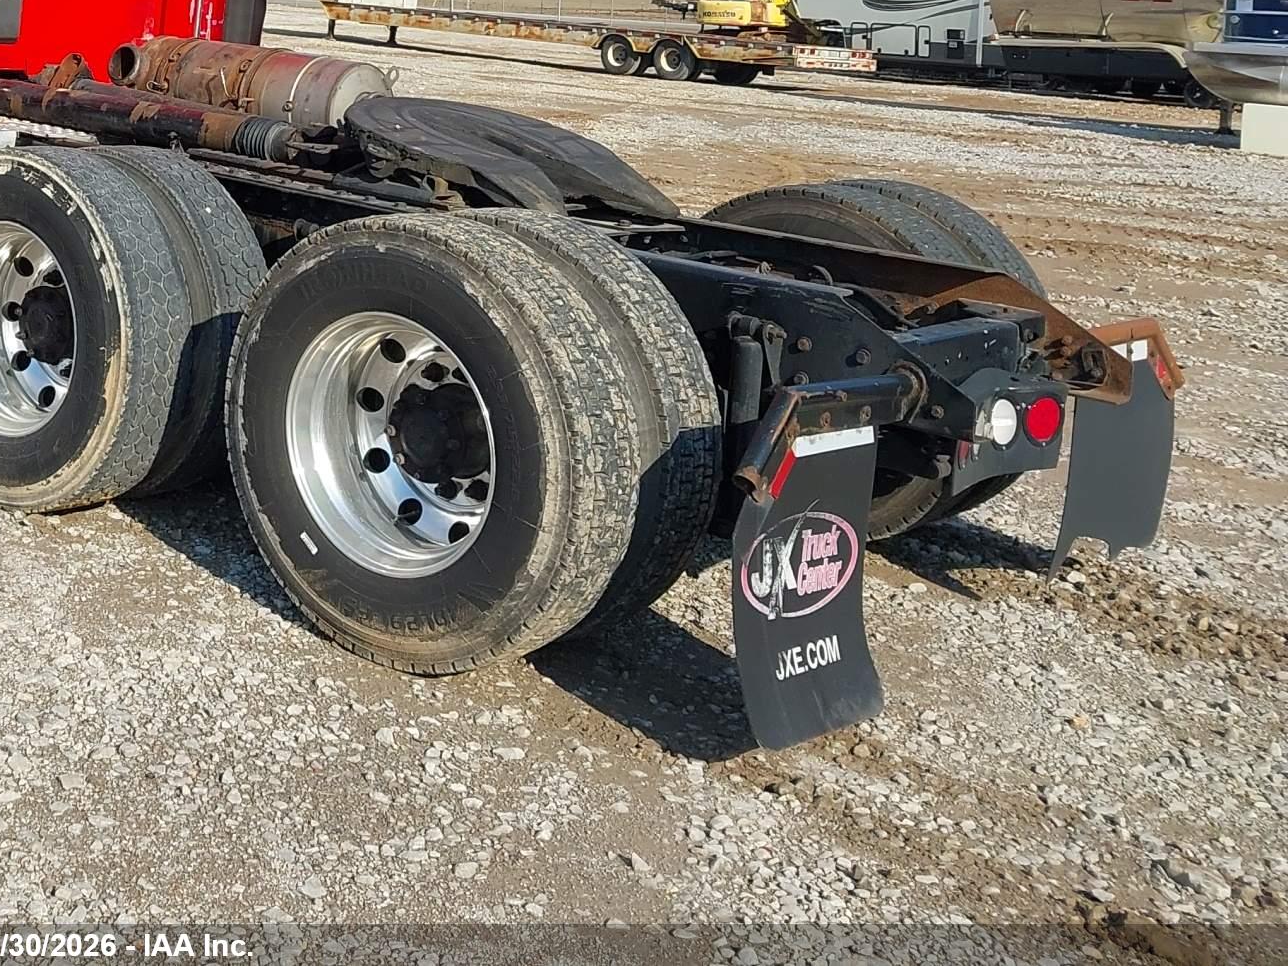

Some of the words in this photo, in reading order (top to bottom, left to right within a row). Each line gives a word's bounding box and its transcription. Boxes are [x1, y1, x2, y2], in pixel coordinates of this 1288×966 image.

[801, 524, 841, 563] Truck
[796, 558, 843, 597] Center
[775, 635, 842, 681] JXE.COM
